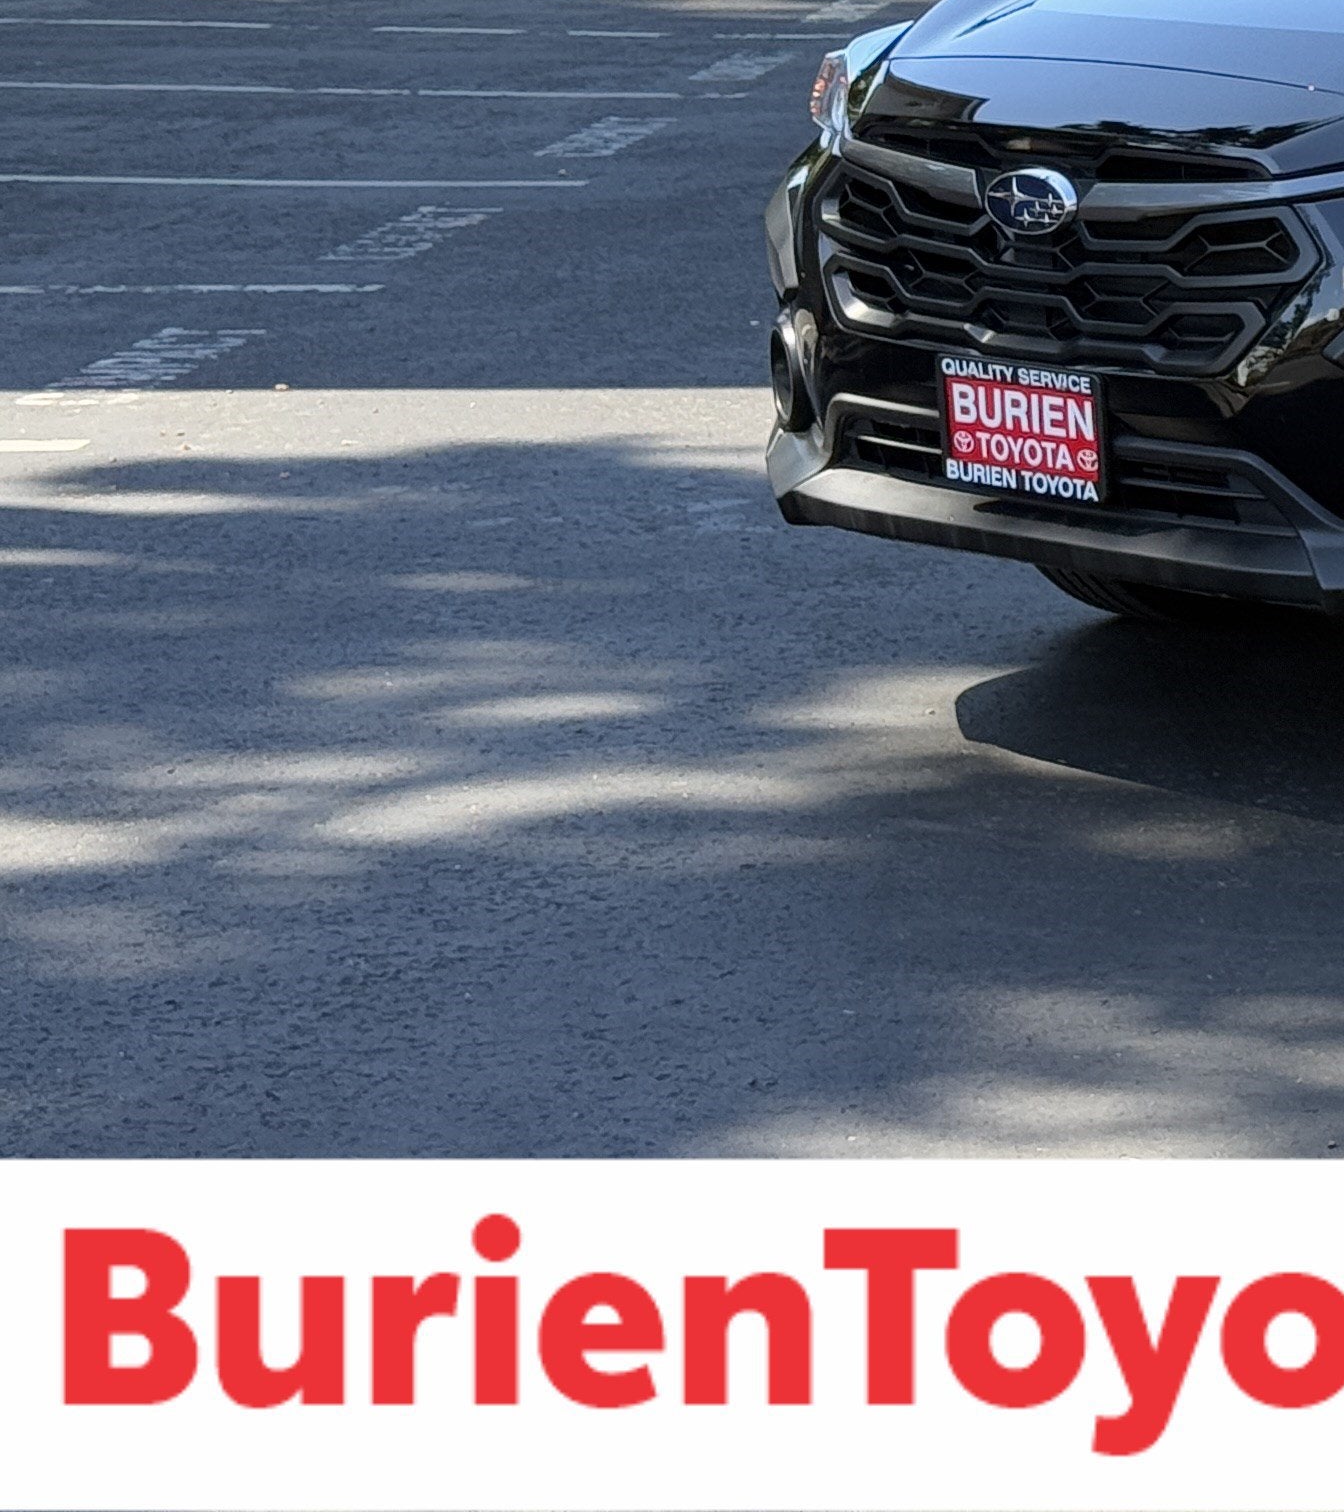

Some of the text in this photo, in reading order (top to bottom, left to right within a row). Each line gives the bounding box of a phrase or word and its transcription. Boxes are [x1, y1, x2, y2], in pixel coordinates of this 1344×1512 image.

[941, 358, 1092, 394] QUALITY SERVICE
[951, 382, 1095, 441] BURIEN
[975, 431, 1076, 471] TOYOTA
[946, 458, 1099, 502] BURIEN TOYOTA
